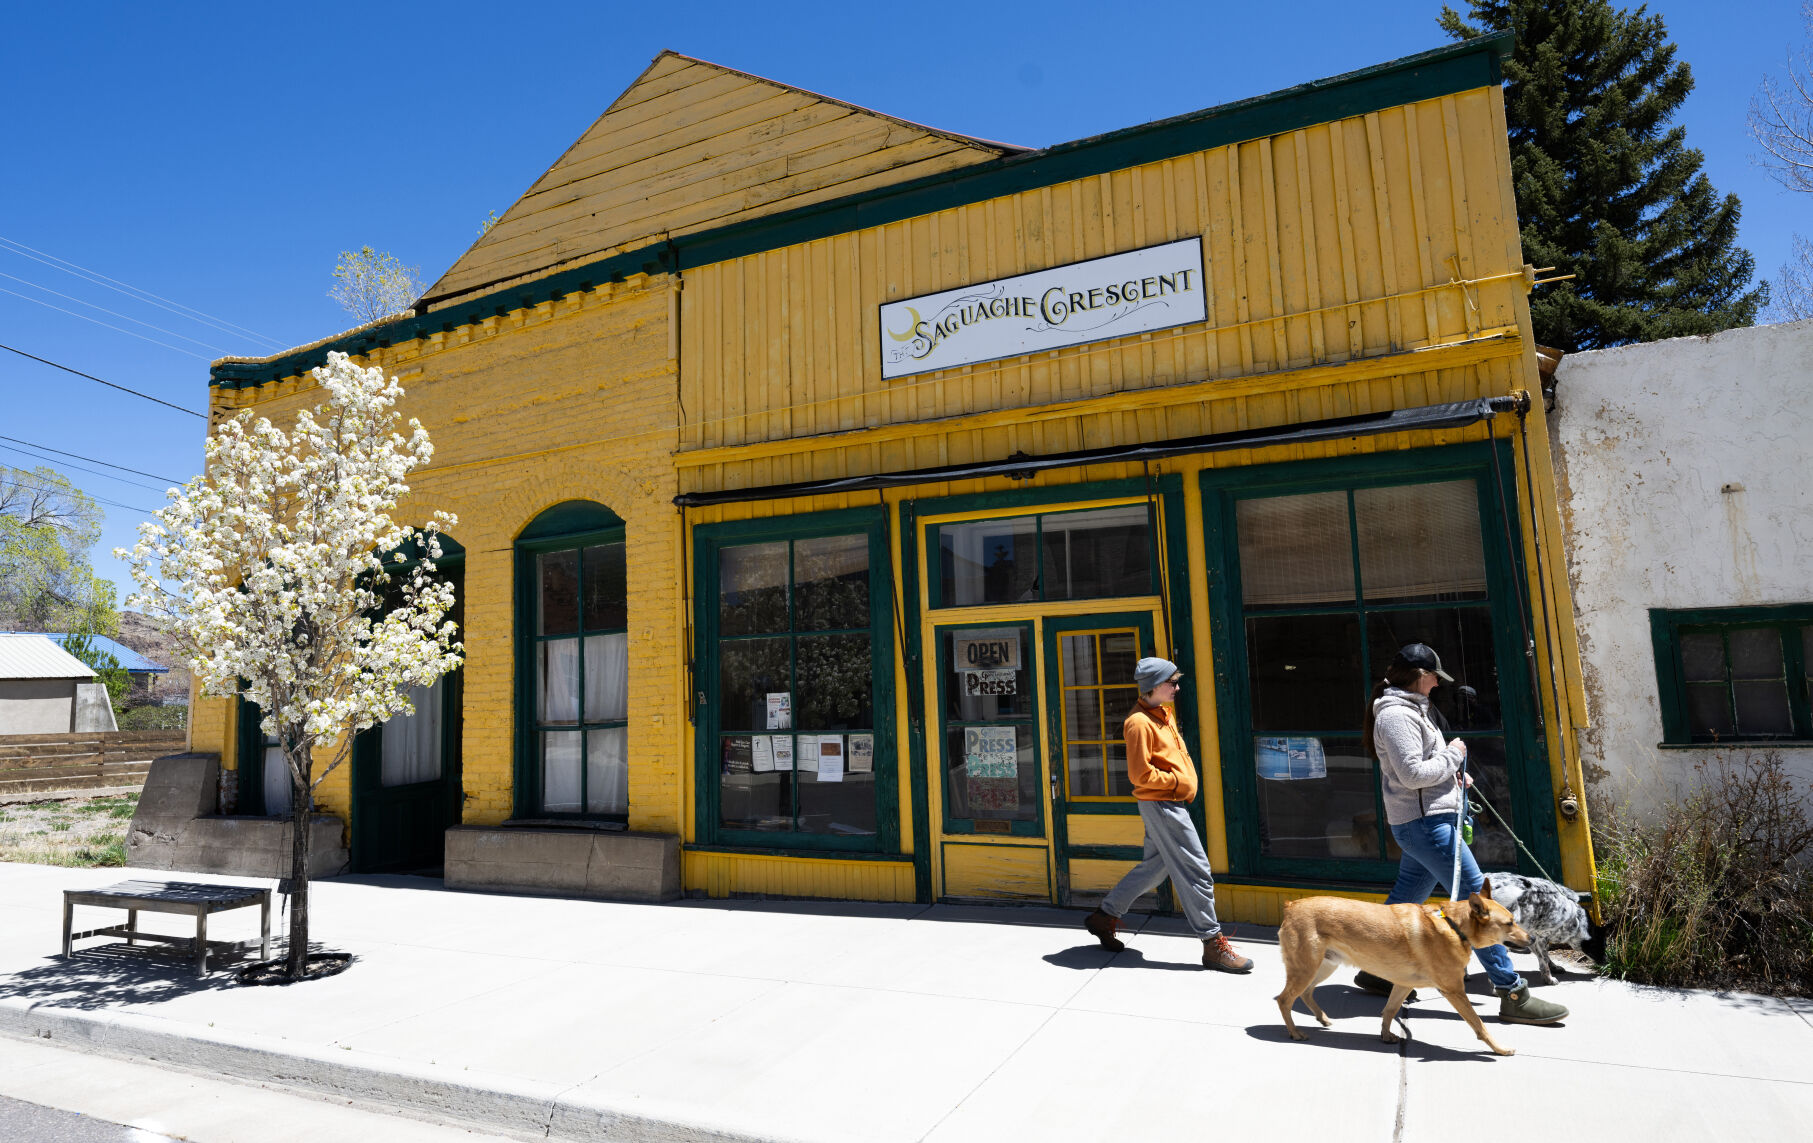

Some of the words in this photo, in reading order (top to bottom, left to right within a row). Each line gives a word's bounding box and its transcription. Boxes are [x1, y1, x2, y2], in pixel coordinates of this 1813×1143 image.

[911, 296, 1036, 360] SAGUACHE
[1039, 269, 1196, 326] CRESCENT
[967, 641, 1009, 664] OPEN
[967, 672, 1015, 695] PRESS
[966, 729, 1015, 753] PRESS
[967, 755, 1017, 777] PRESS
